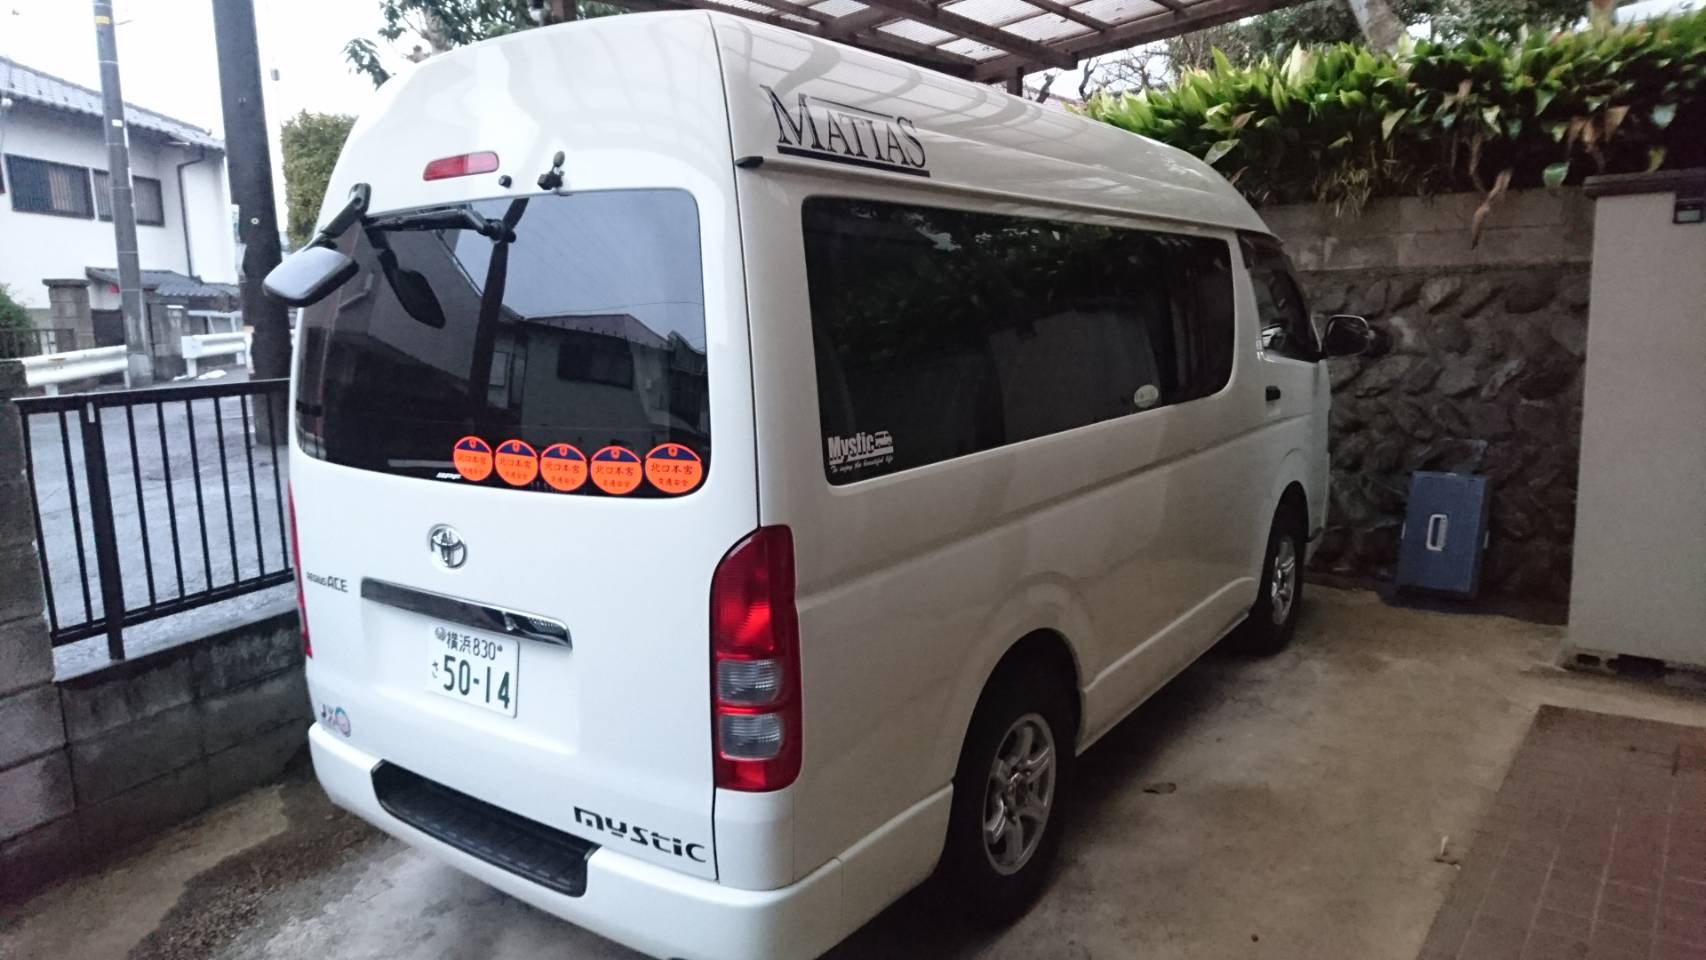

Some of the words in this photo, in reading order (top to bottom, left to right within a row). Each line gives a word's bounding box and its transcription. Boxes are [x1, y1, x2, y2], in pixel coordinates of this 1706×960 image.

[759, 84, 926, 168] MATIAS
[828, 431, 874, 461] Mystic
[651, 462, 693, 475] 北口本宮
[443, 654, 510, 709] 50-14
